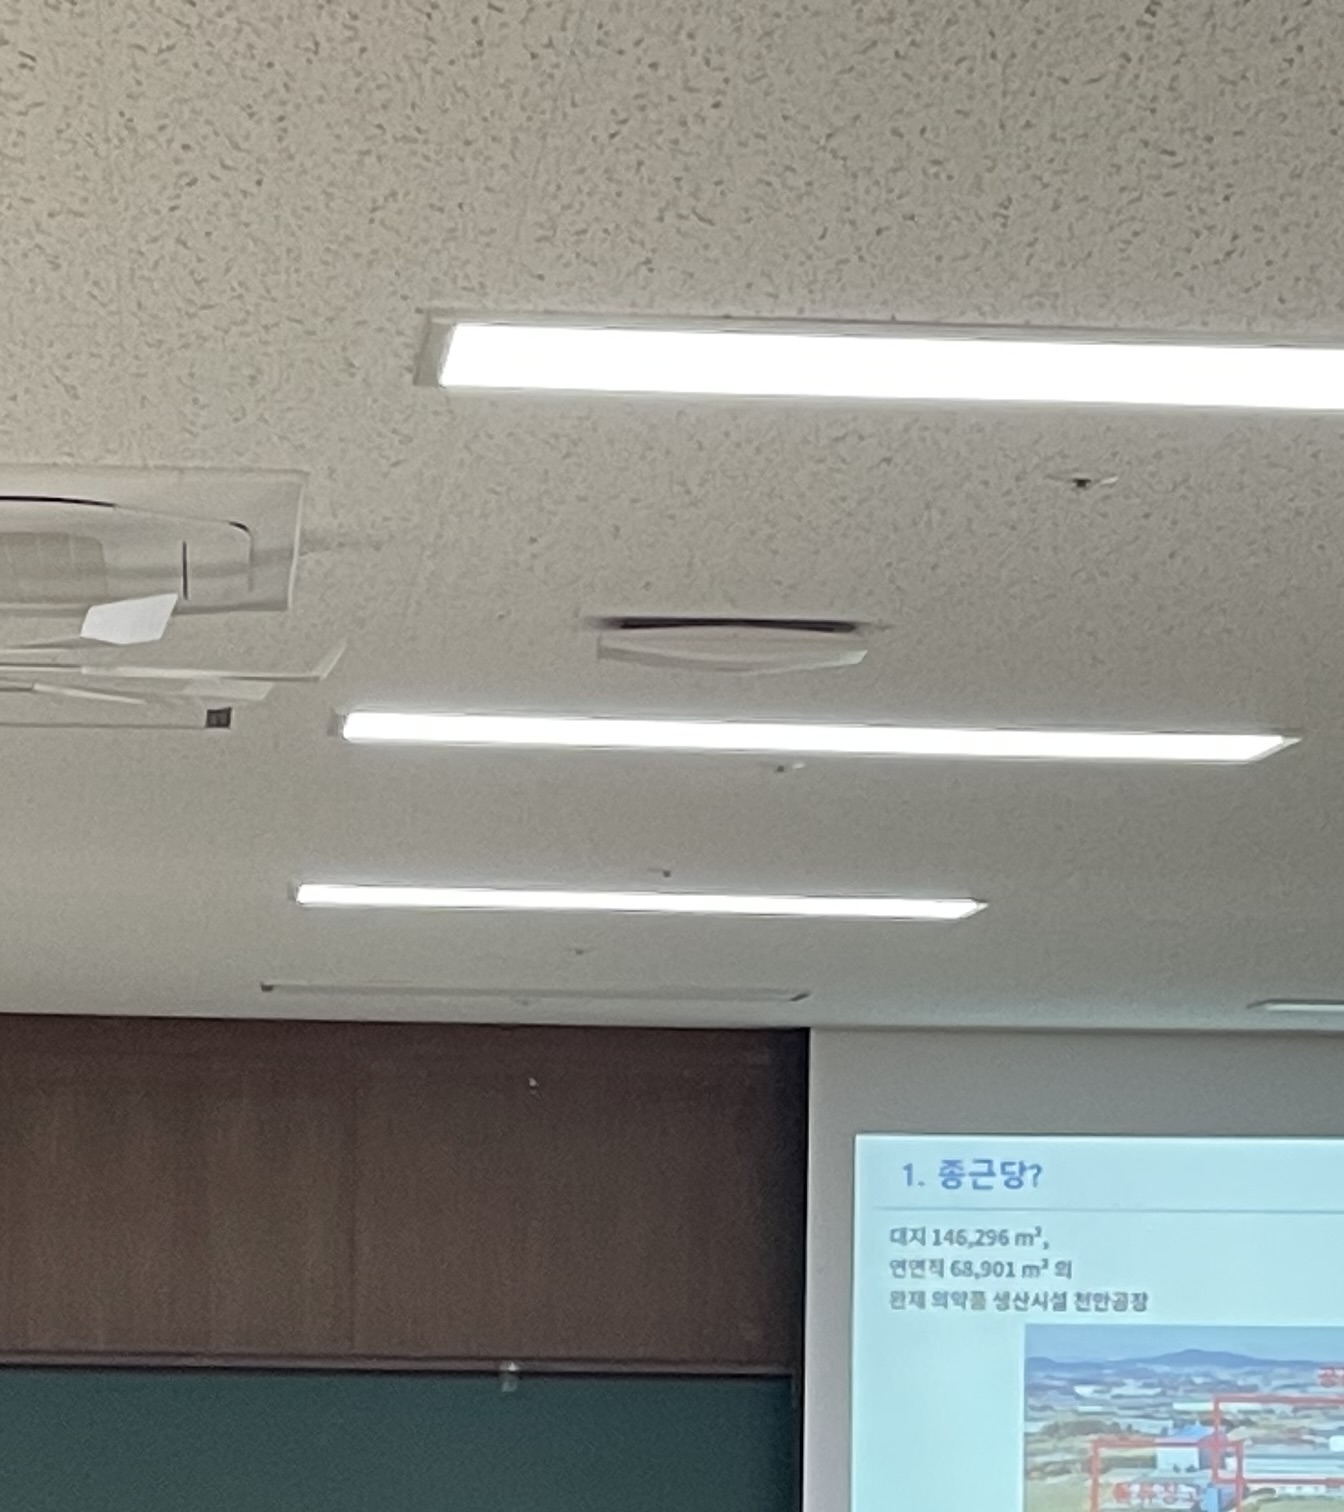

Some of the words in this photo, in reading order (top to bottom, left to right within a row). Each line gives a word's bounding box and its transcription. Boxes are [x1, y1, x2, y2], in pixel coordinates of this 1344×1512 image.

[902, 1162, 926, 1187] 1.
[938, 1158, 1044, 1191] 종근당?
[889, 1226, 927, 1247] 대지
[932, 1228, 1011, 1249] 146,296
[889, 1257, 945, 1280] 연면적
[950, 1259, 1016, 1280] 68,901
[931, 1289, 988, 1311] 의약품
[993, 1290, 1068, 1312] 생산시설
[1074, 1291, 1149, 1313] 천안공장
